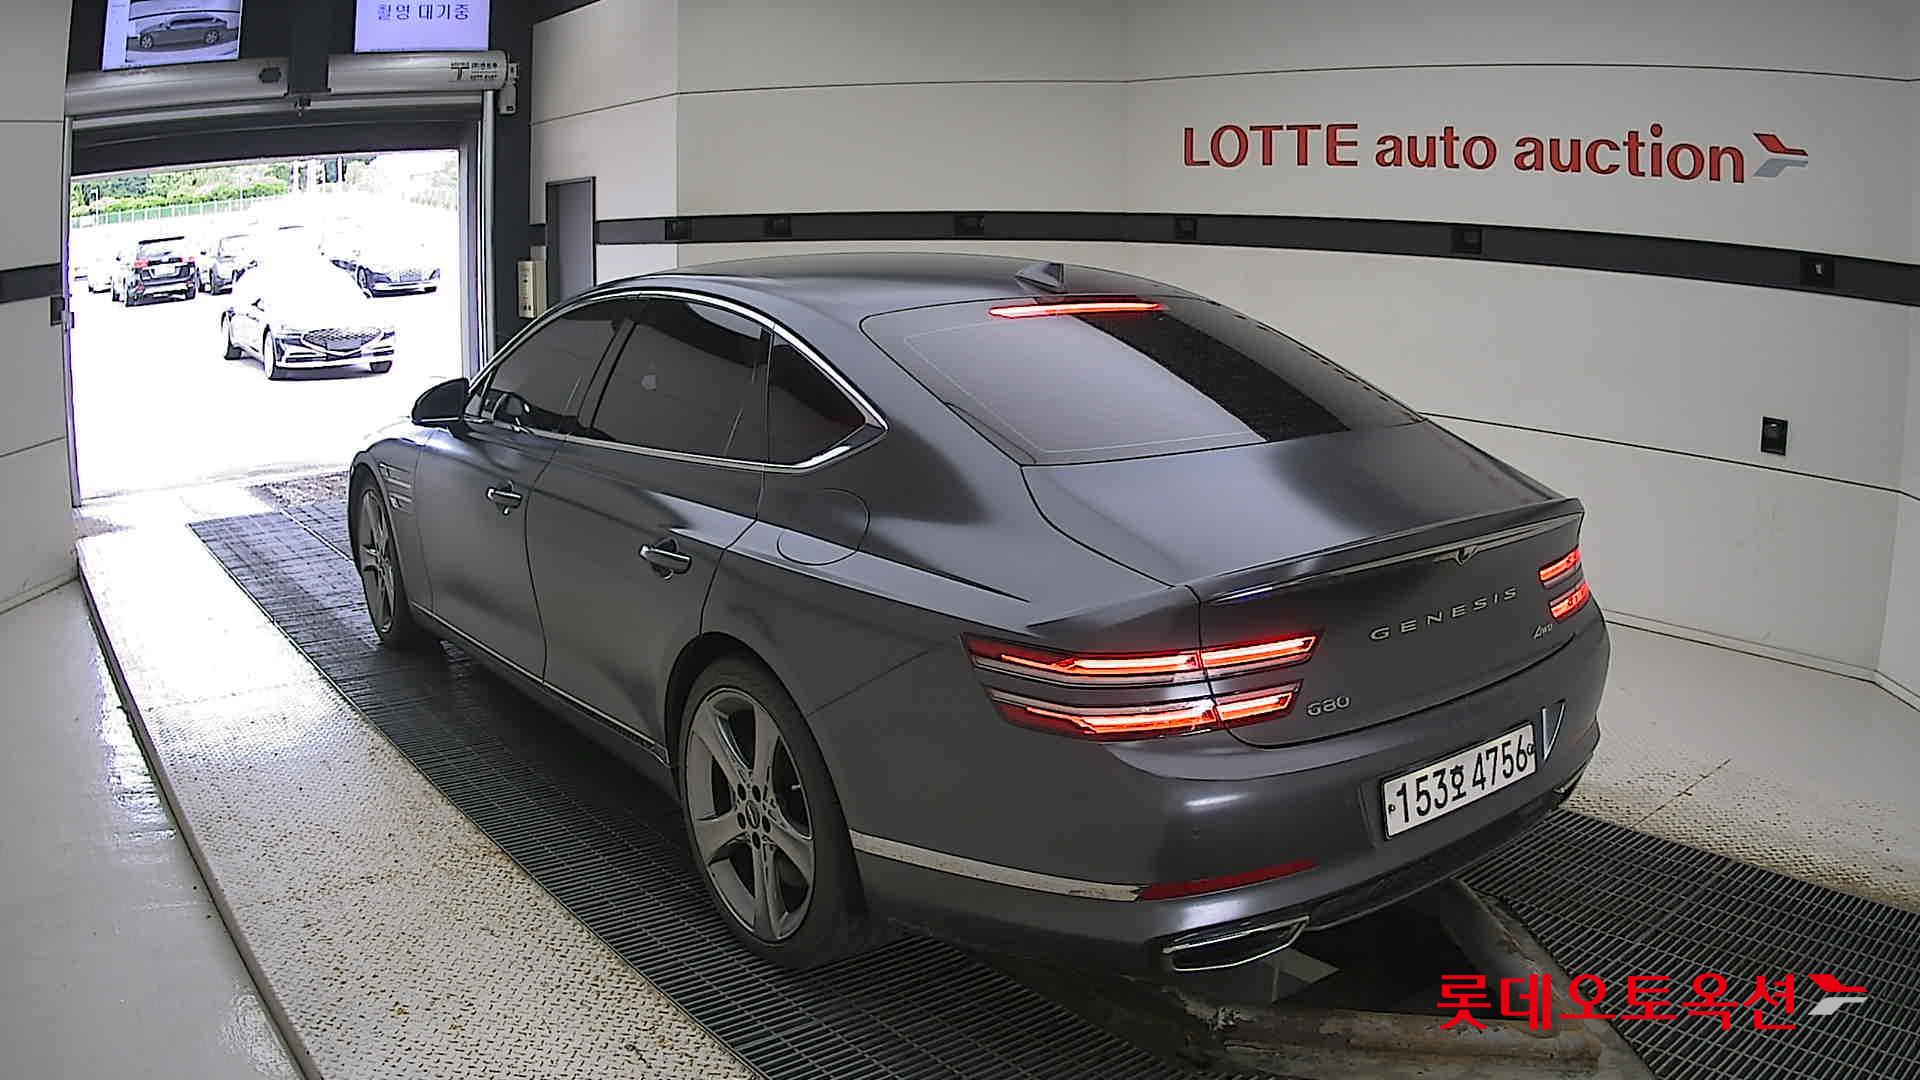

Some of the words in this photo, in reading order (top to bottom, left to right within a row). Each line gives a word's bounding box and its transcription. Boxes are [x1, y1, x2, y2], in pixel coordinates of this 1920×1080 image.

[418, 4, 469, 20] 대기중
[1184, 124, 1358, 168] LOTTE
[1375, 126, 1497, 169] auto
[1513, 123, 1745, 183] auction
[1370, 588, 1517, 640] GENESIS
[1307, 696, 1350, 716] G80
[1396, 764, 1467, 823] 153호
[1472, 734, 1528, 790] 4756
